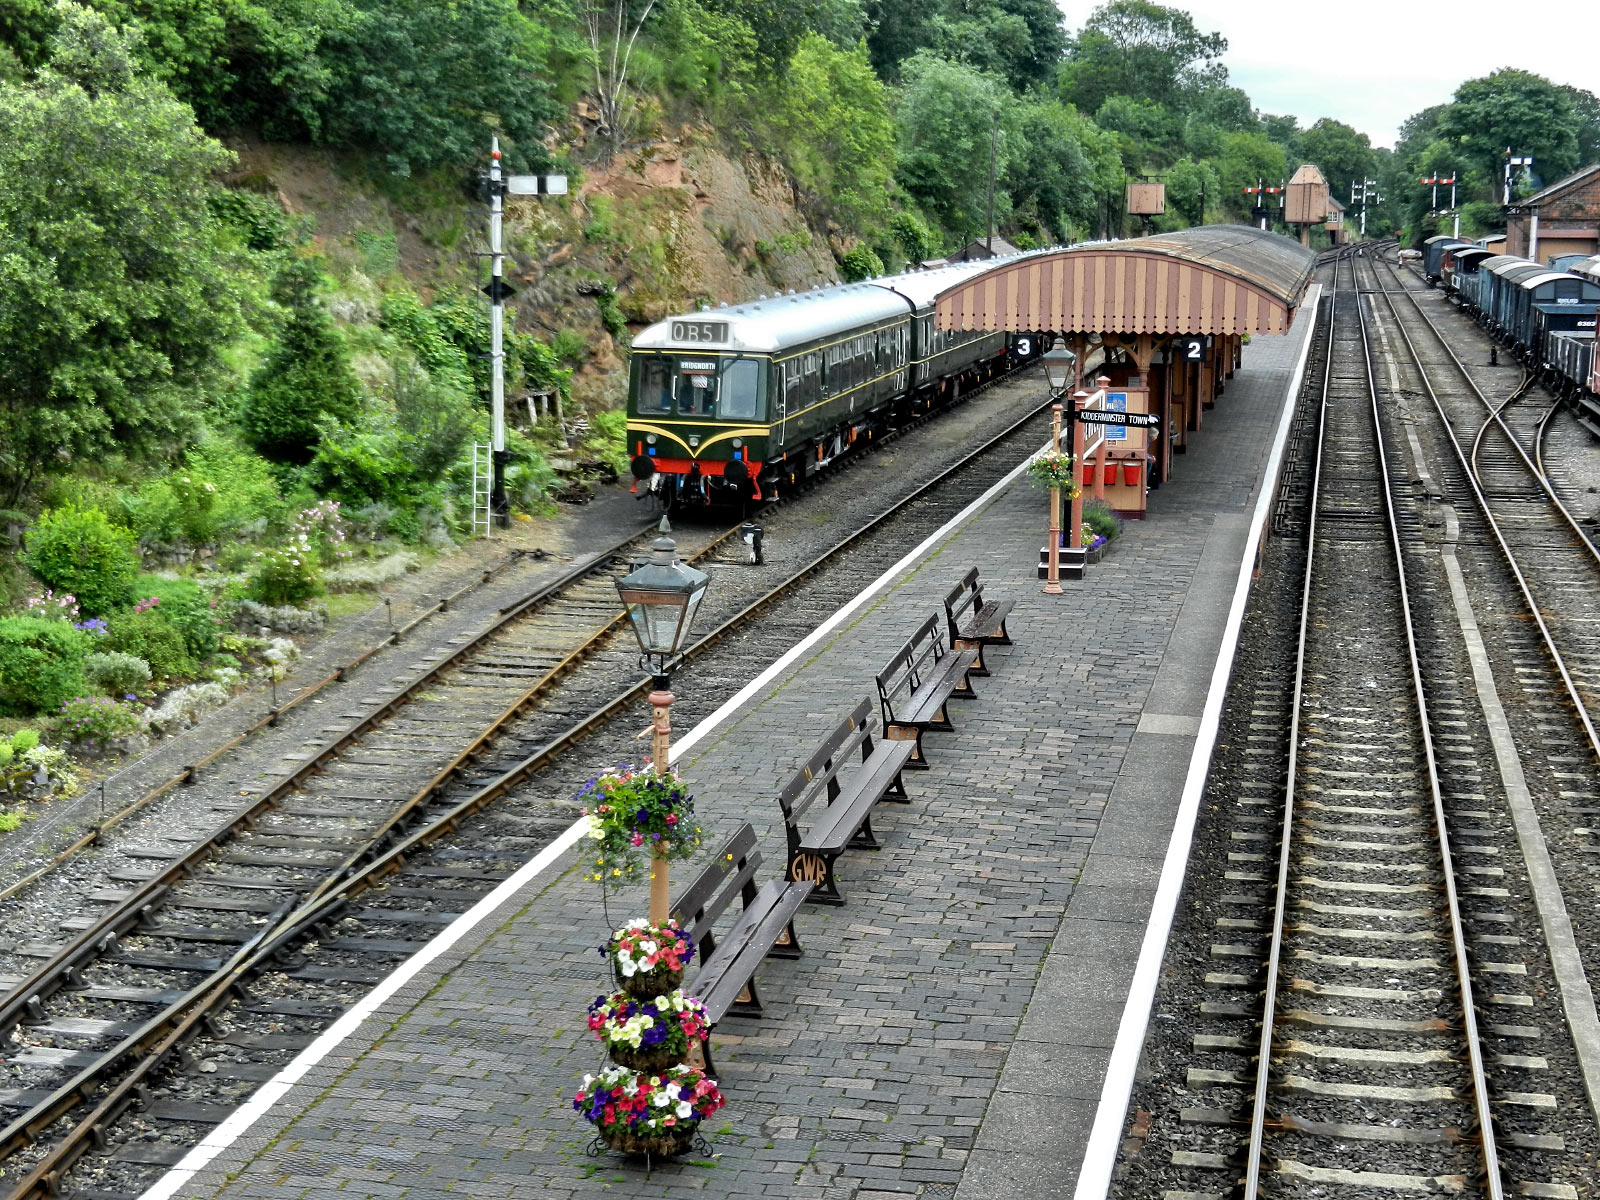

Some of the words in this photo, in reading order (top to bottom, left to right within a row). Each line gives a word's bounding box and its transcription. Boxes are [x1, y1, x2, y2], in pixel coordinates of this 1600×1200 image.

[1017, 339, 1031, 355] 3
[1187, 342, 1201, 358] 2
[680, 361, 716, 370] BRIDGNORTH
[1080, 411, 1126, 423] KIDDERMINSTER
[1128, 415, 1148, 425] TOWN
[791, 853, 827, 886] GWR
